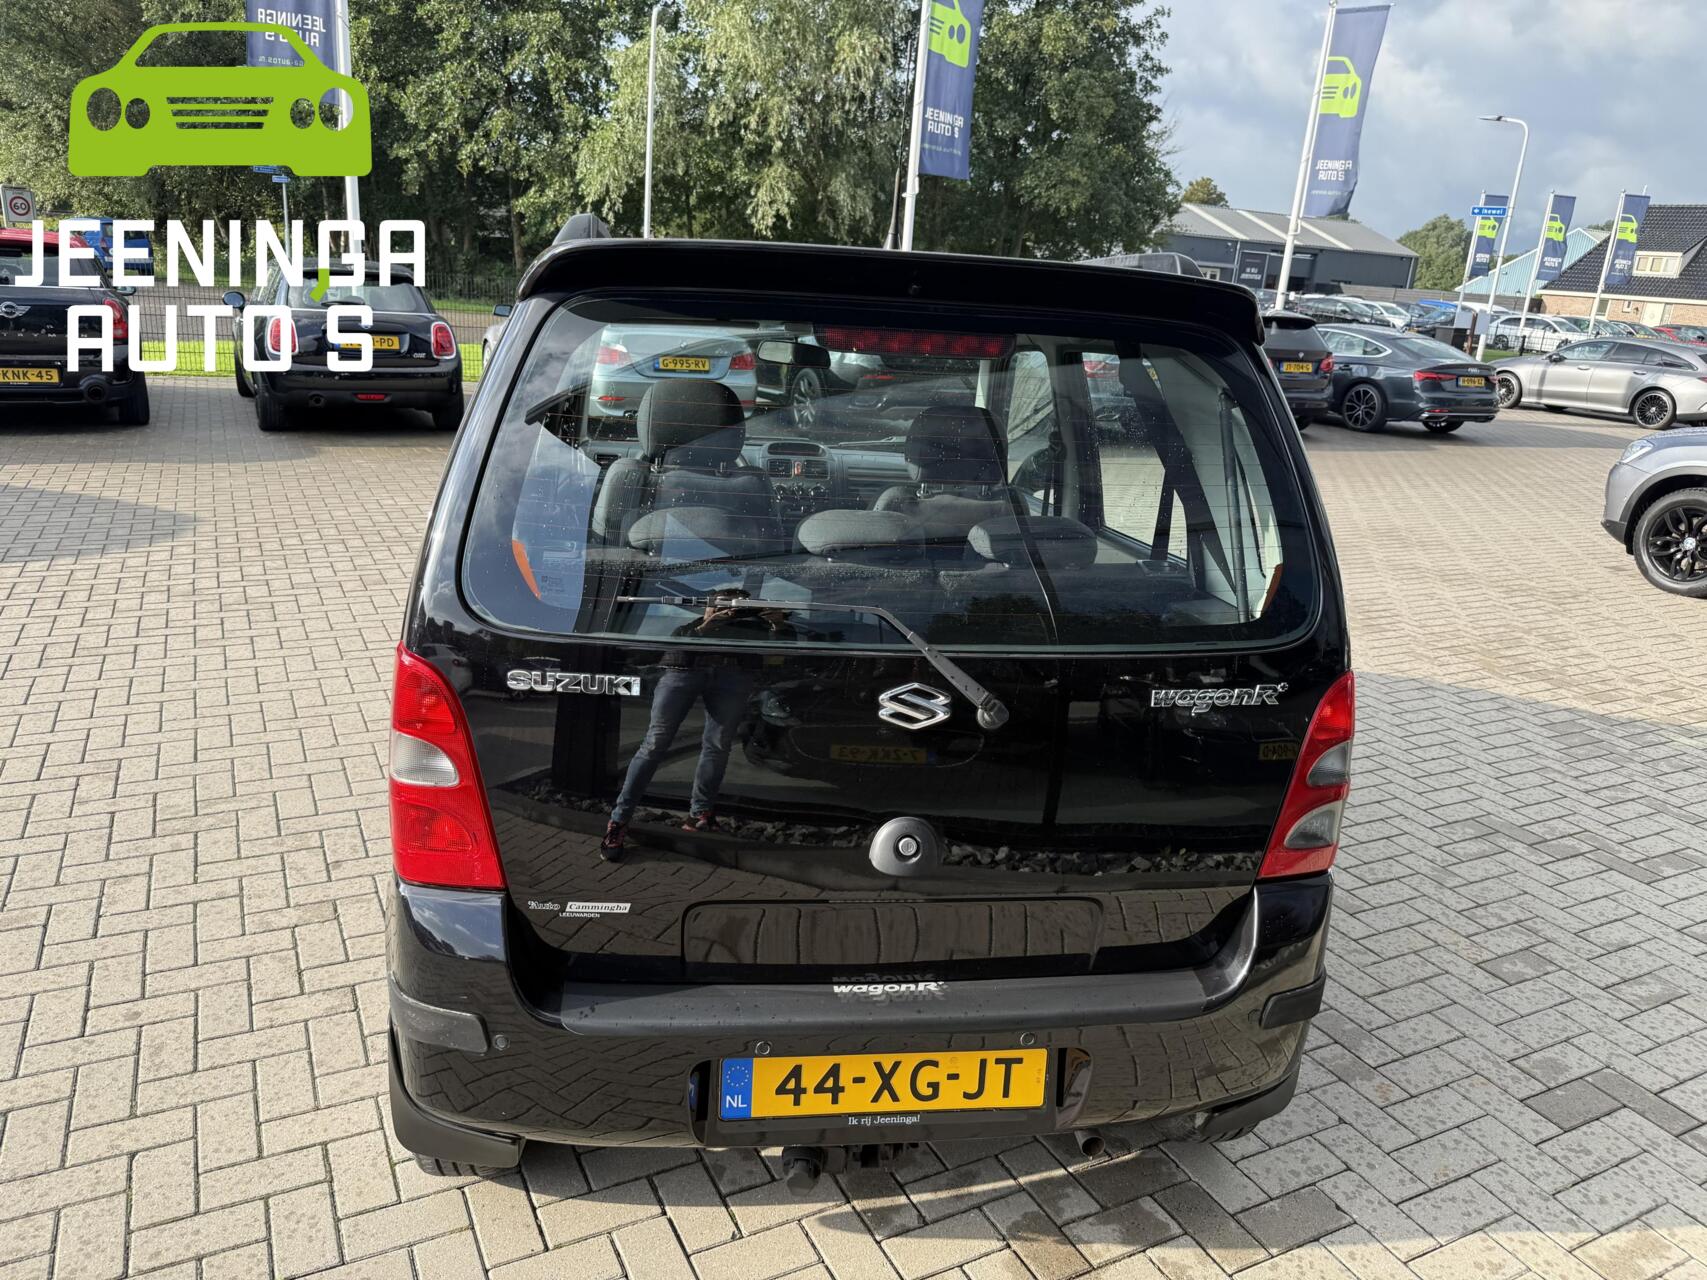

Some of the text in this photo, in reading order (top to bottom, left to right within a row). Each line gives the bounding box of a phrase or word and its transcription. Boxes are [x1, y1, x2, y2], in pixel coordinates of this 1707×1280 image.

[924, 106, 964, 128] JEENINGA
[13, 202, 27, 211] 60
[662, 359, 707, 369] G-995-RV
[506, 669, 641, 696] SUZUKI
[568, 903, 628, 912] Cammingha
[725, 1095, 748, 1108] NL
[774, 1057, 1024, 1107] 44-XG-JT
[848, 1114, 921, 1126] Ik rij Jeeninga!
